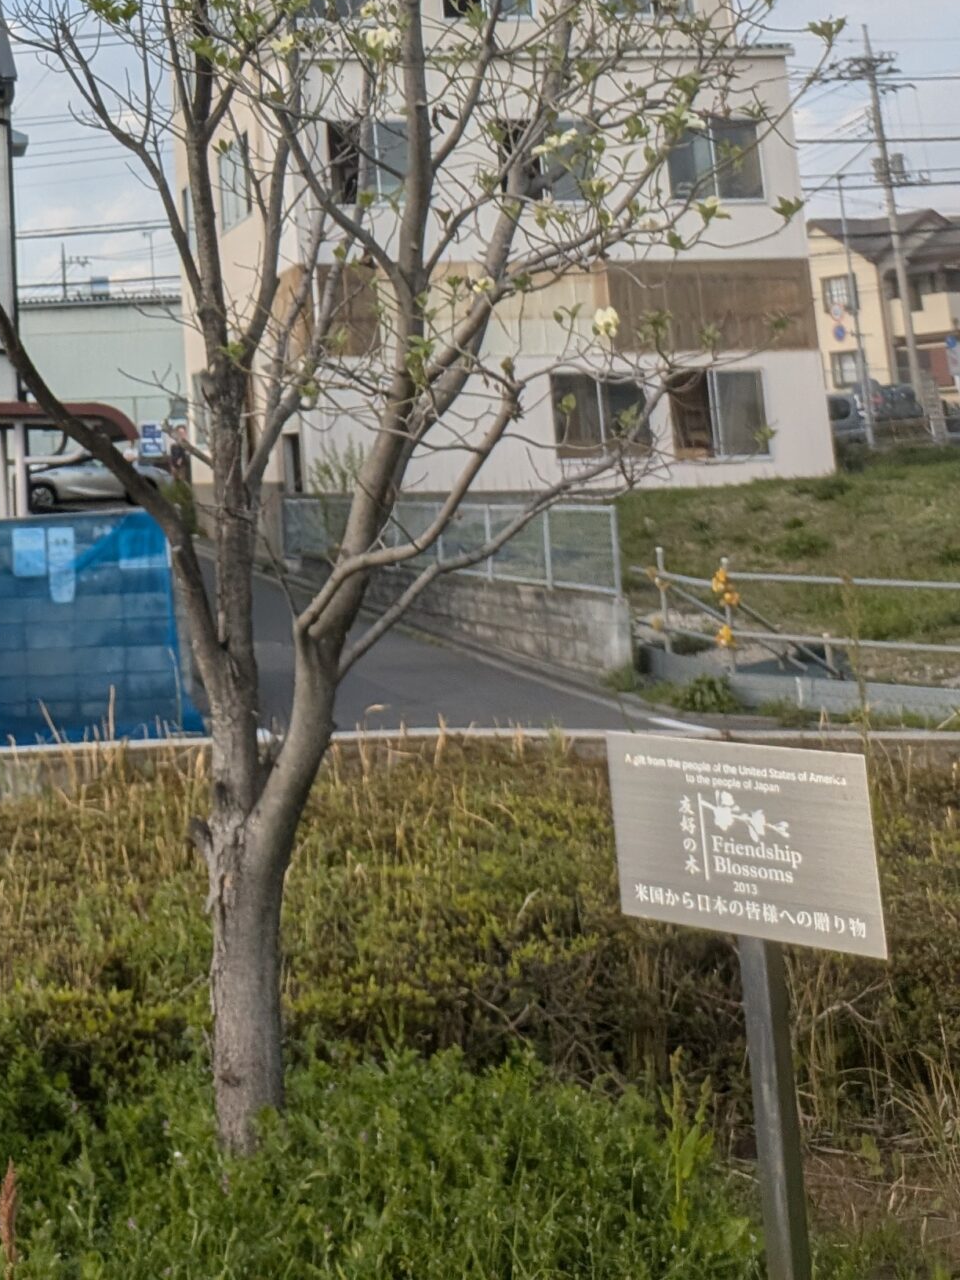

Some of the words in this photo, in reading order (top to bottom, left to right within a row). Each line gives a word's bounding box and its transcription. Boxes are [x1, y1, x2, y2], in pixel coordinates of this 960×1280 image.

[624, 753, 632, 763] A
[633, 754, 646, 767] gift
[646, 755, 666, 767] from
[666, 758, 681, 769] the
[681, 761, 711, 773] people
[712, 762, 721, 772] of
[722, 763, 737, 775] the
[738, 764, 767, 778] United
[768, 767, 796, 781] States
[797, 771, 807, 782] of
[809, 772, 847, 786] America
[685, 773, 695, 784] to
[696, 774, 711, 785] the
[711, 777, 741, 790] people
[742, 779, 752, 789] of
[753, 781, 780, 793] Japan
[678, 794, 701, 874] 友好の木
[711, 834, 803, 869] Friendship
[713, 855, 794, 884] Blossoms
[733, 880, 758, 895] 2013
[634, 882, 866, 938] 米国から日本の皆様への贈り物
